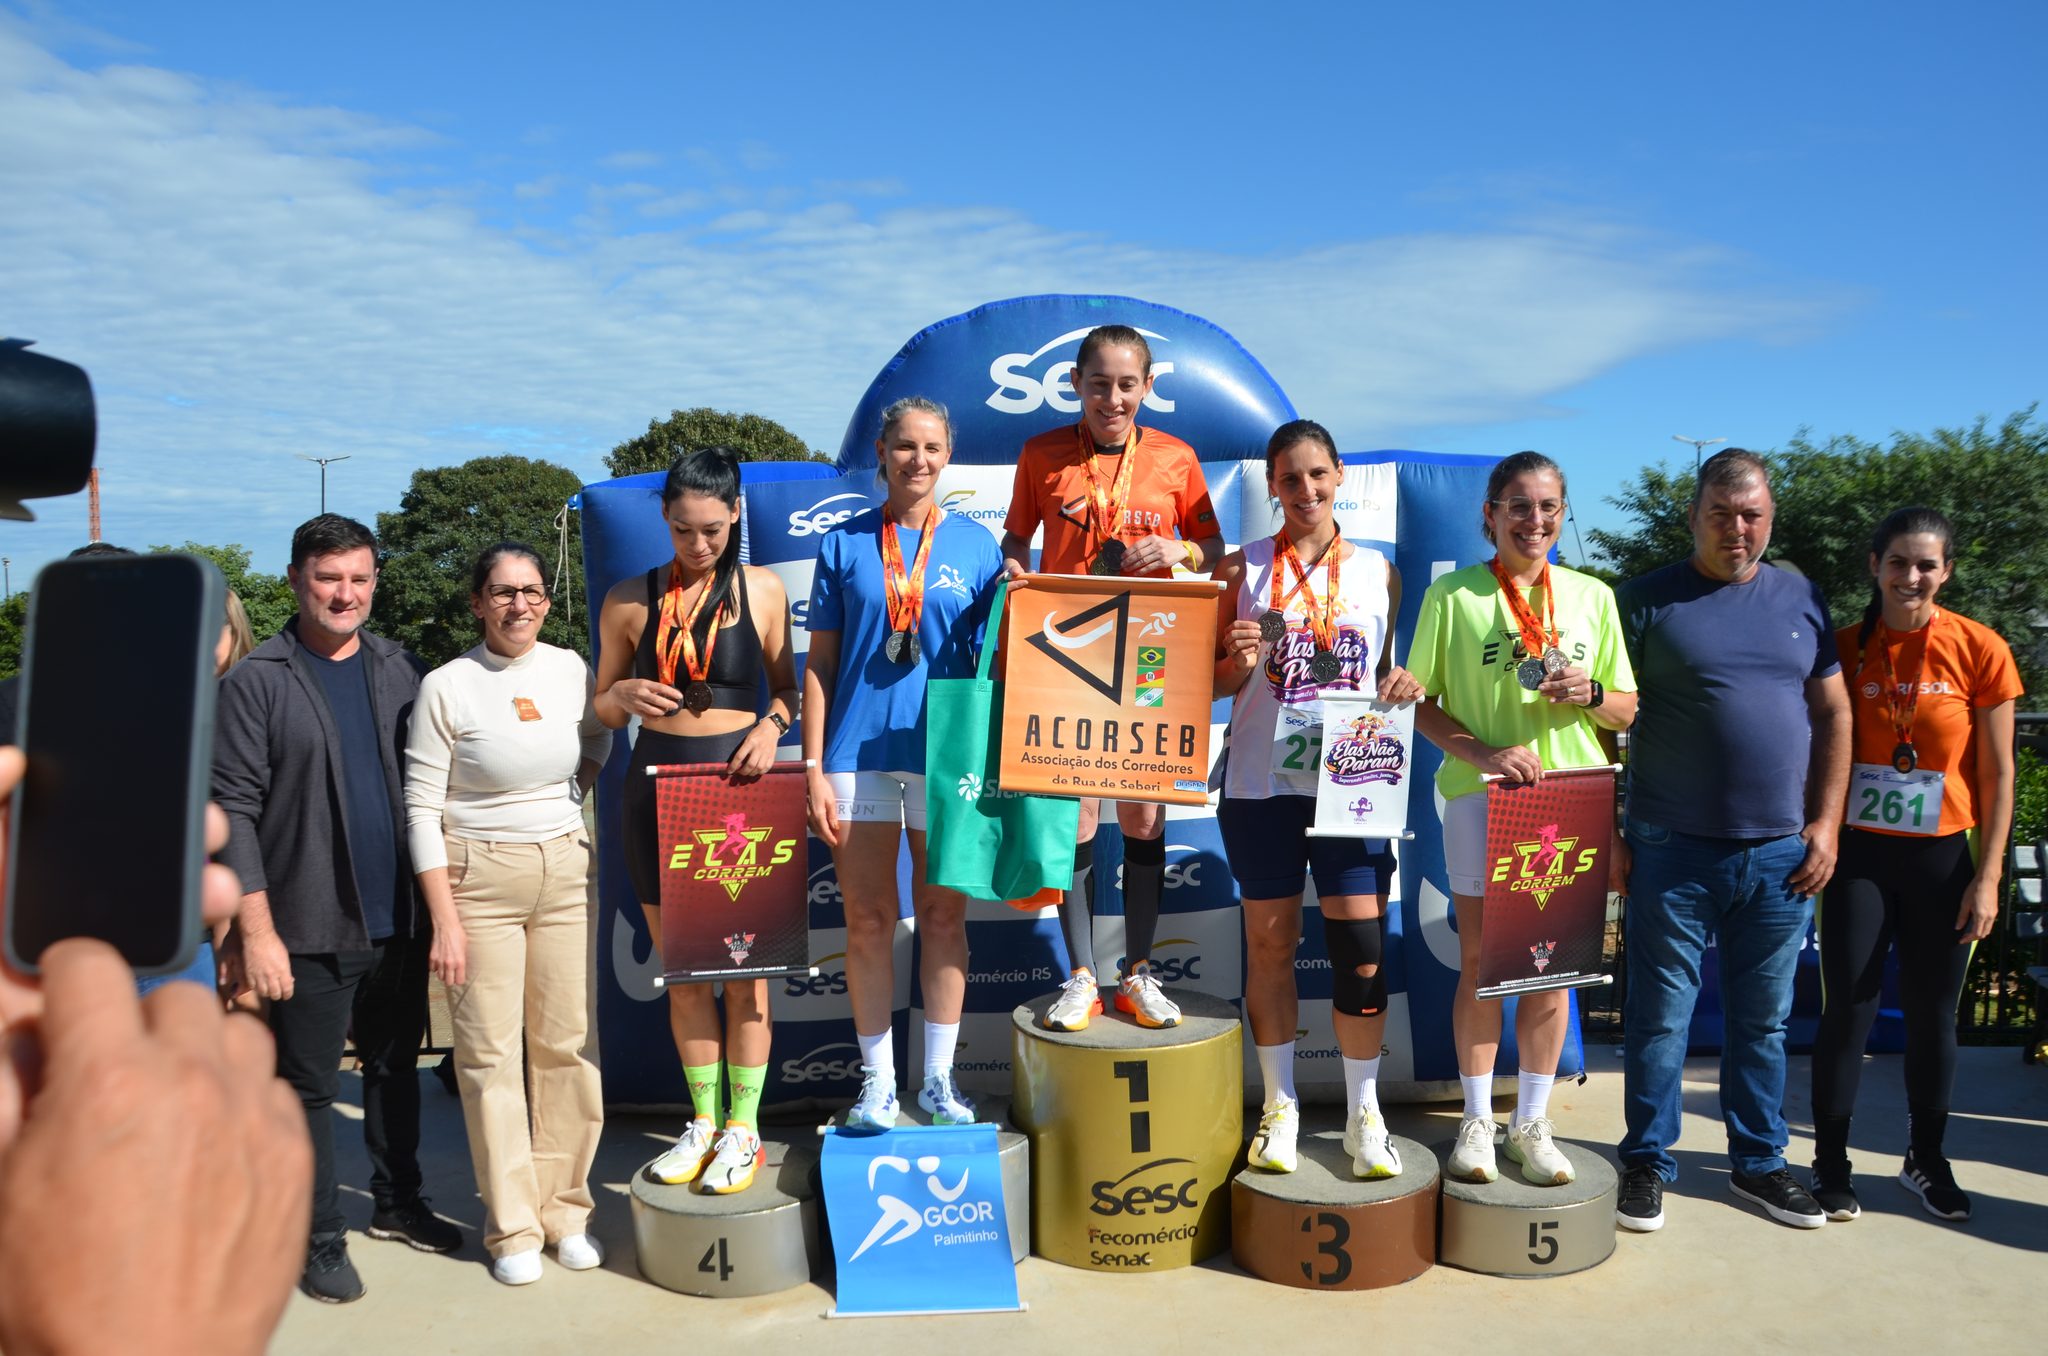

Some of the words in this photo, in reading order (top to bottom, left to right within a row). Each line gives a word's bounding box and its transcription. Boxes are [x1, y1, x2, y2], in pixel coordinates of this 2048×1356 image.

[985, 353, 1175, 414] Sec
[787, 508, 872, 536] Ses
[1482, 642, 1586, 666] ELS
[1024, 714, 1196, 758] ACORSEB
[1333, 739, 1364, 760] Elas
[1361, 739, 1397, 760] Não
[1021, 752, 1090, 770] Associação
[1095, 757, 1118, 770] dos
[1121, 759, 1193, 775] Corredores
[1338, 756, 1400, 775] Param
[1052, 775, 1067, 785] de
[1073, 776, 1096, 787] Rua
[1100, 779, 1116, 789] de
[1120, 779, 1161, 792] Seberi
[838, 804, 876, 816] RUN
[1858, 787, 1925, 827] 261
[669, 839, 797, 869] ELAS
[1491, 848, 1598, 883] ELAS
[693, 865, 773, 880] CORREM
[1510, 874, 1576, 892] CORREM
[1032, 967, 1052, 981] RS
[1113, 1060, 1151, 1153] 1
[923, 1201, 995, 1228] GCOR
[933, 1229, 999, 1247] Palmitinho
[1088, 1223, 1199, 1246] Fecomércio
[1527, 1221, 1559, 1265] 5
[697, 1237, 735, 1282] 4
[1090, 1250, 1152, 1267] Senac
[1301, 1212, 1353, 1286] 3
